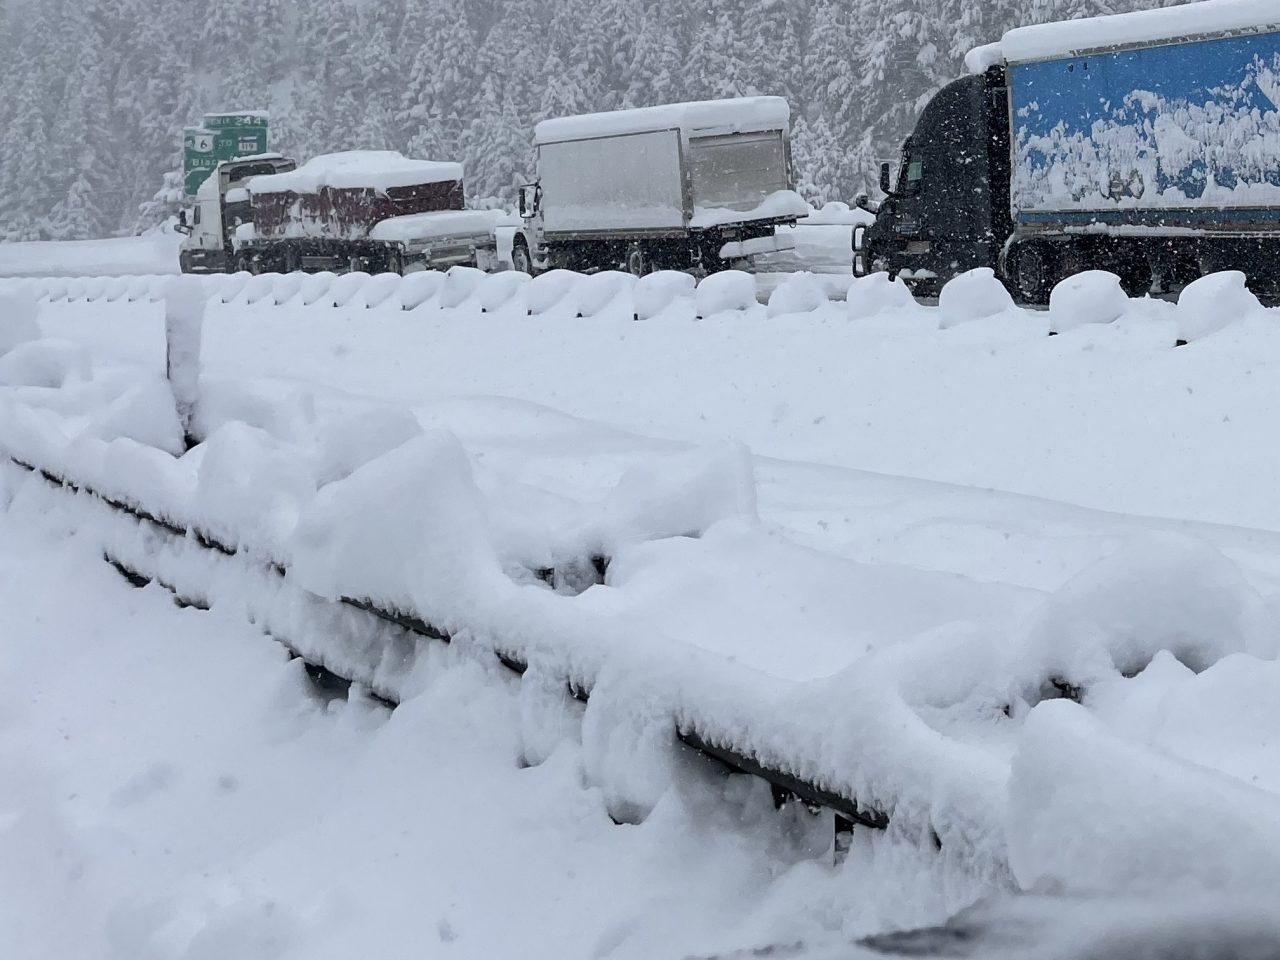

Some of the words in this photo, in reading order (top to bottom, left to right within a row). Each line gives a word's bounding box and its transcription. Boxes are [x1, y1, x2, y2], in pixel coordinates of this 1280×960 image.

[234, 115, 261, 126] 244
[200, 139, 208, 149] 6
[192, 158, 218, 167] Blac
